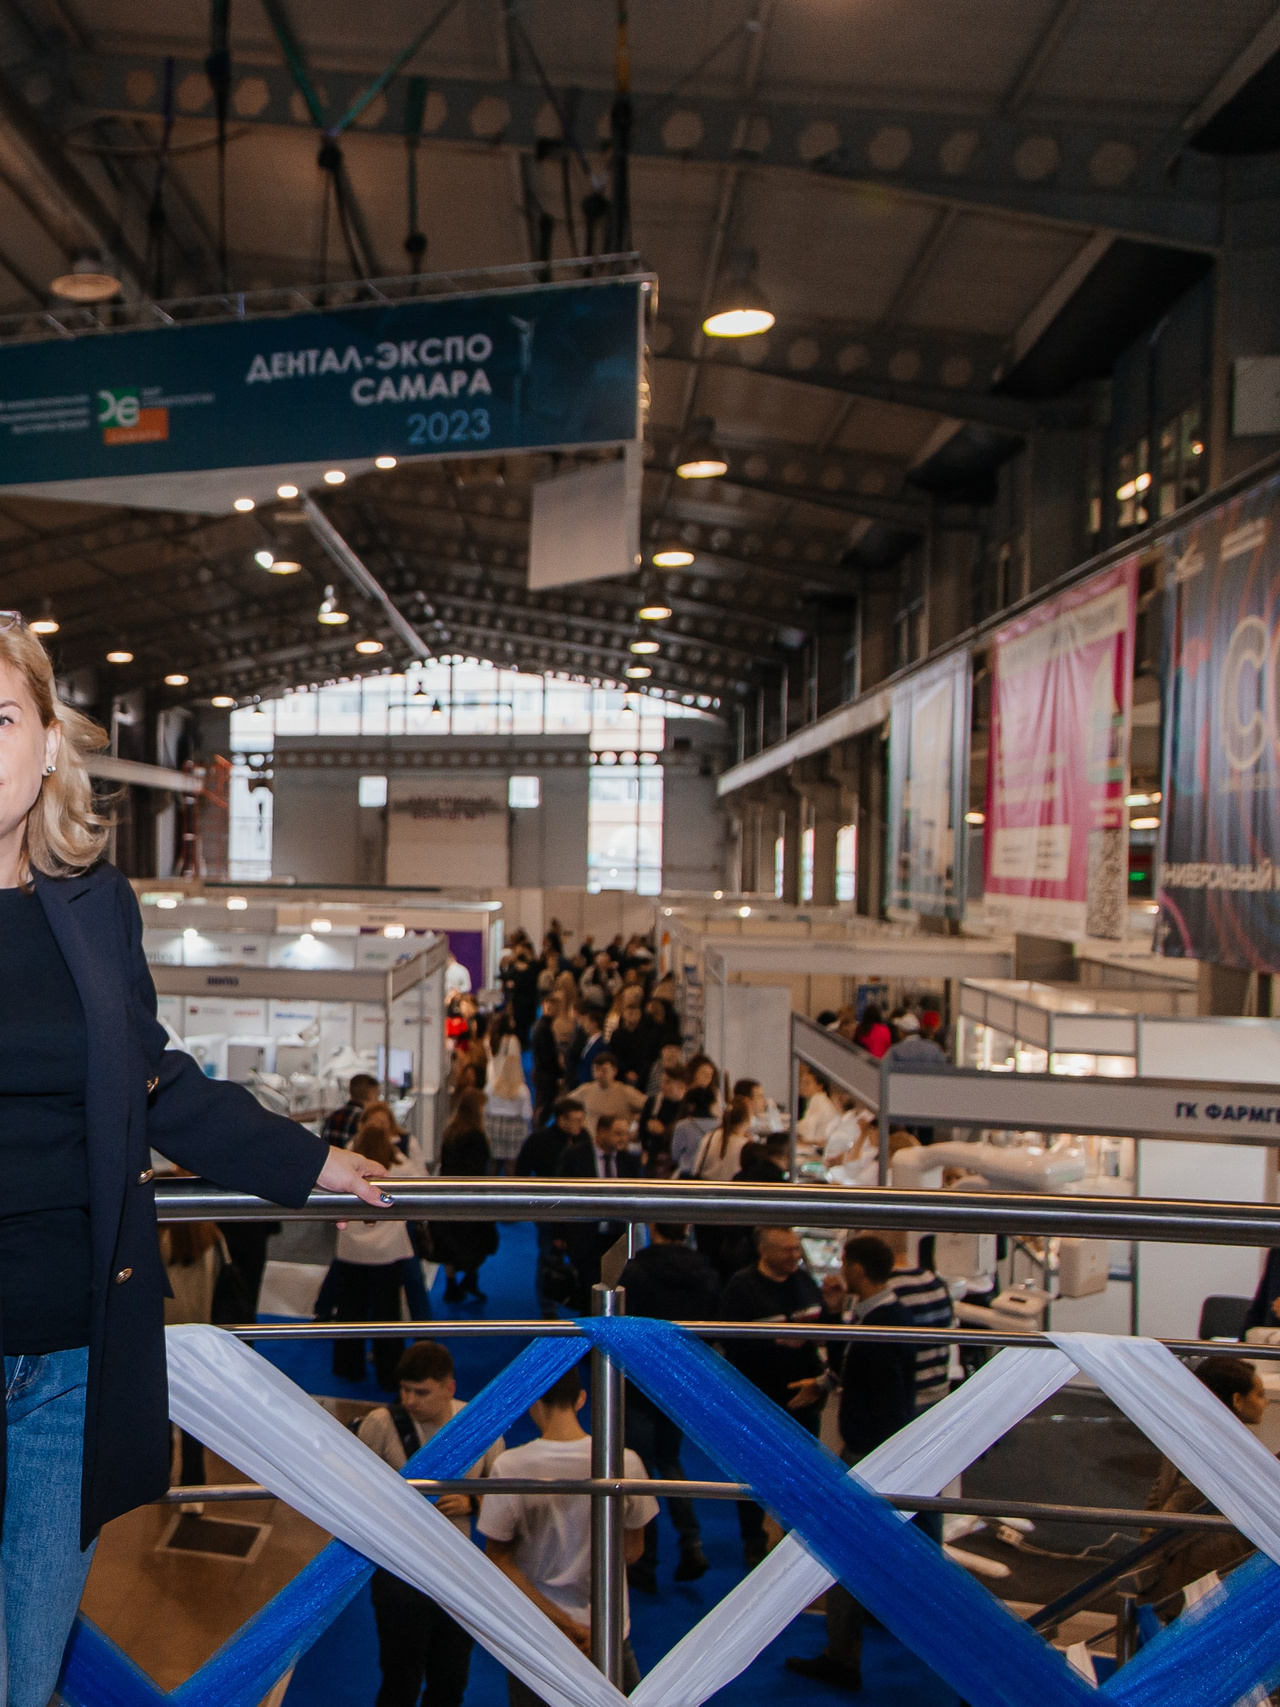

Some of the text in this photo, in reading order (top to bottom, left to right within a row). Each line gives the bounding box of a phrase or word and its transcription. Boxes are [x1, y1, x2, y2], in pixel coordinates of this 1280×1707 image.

[246, 333, 493, 385] ДЕНТАЛ-ЭКСПО
[350, 368, 492, 406] САМАРА
[407, 408, 491, 444] 2023
[1176, 1102, 1198, 1120] ГК
